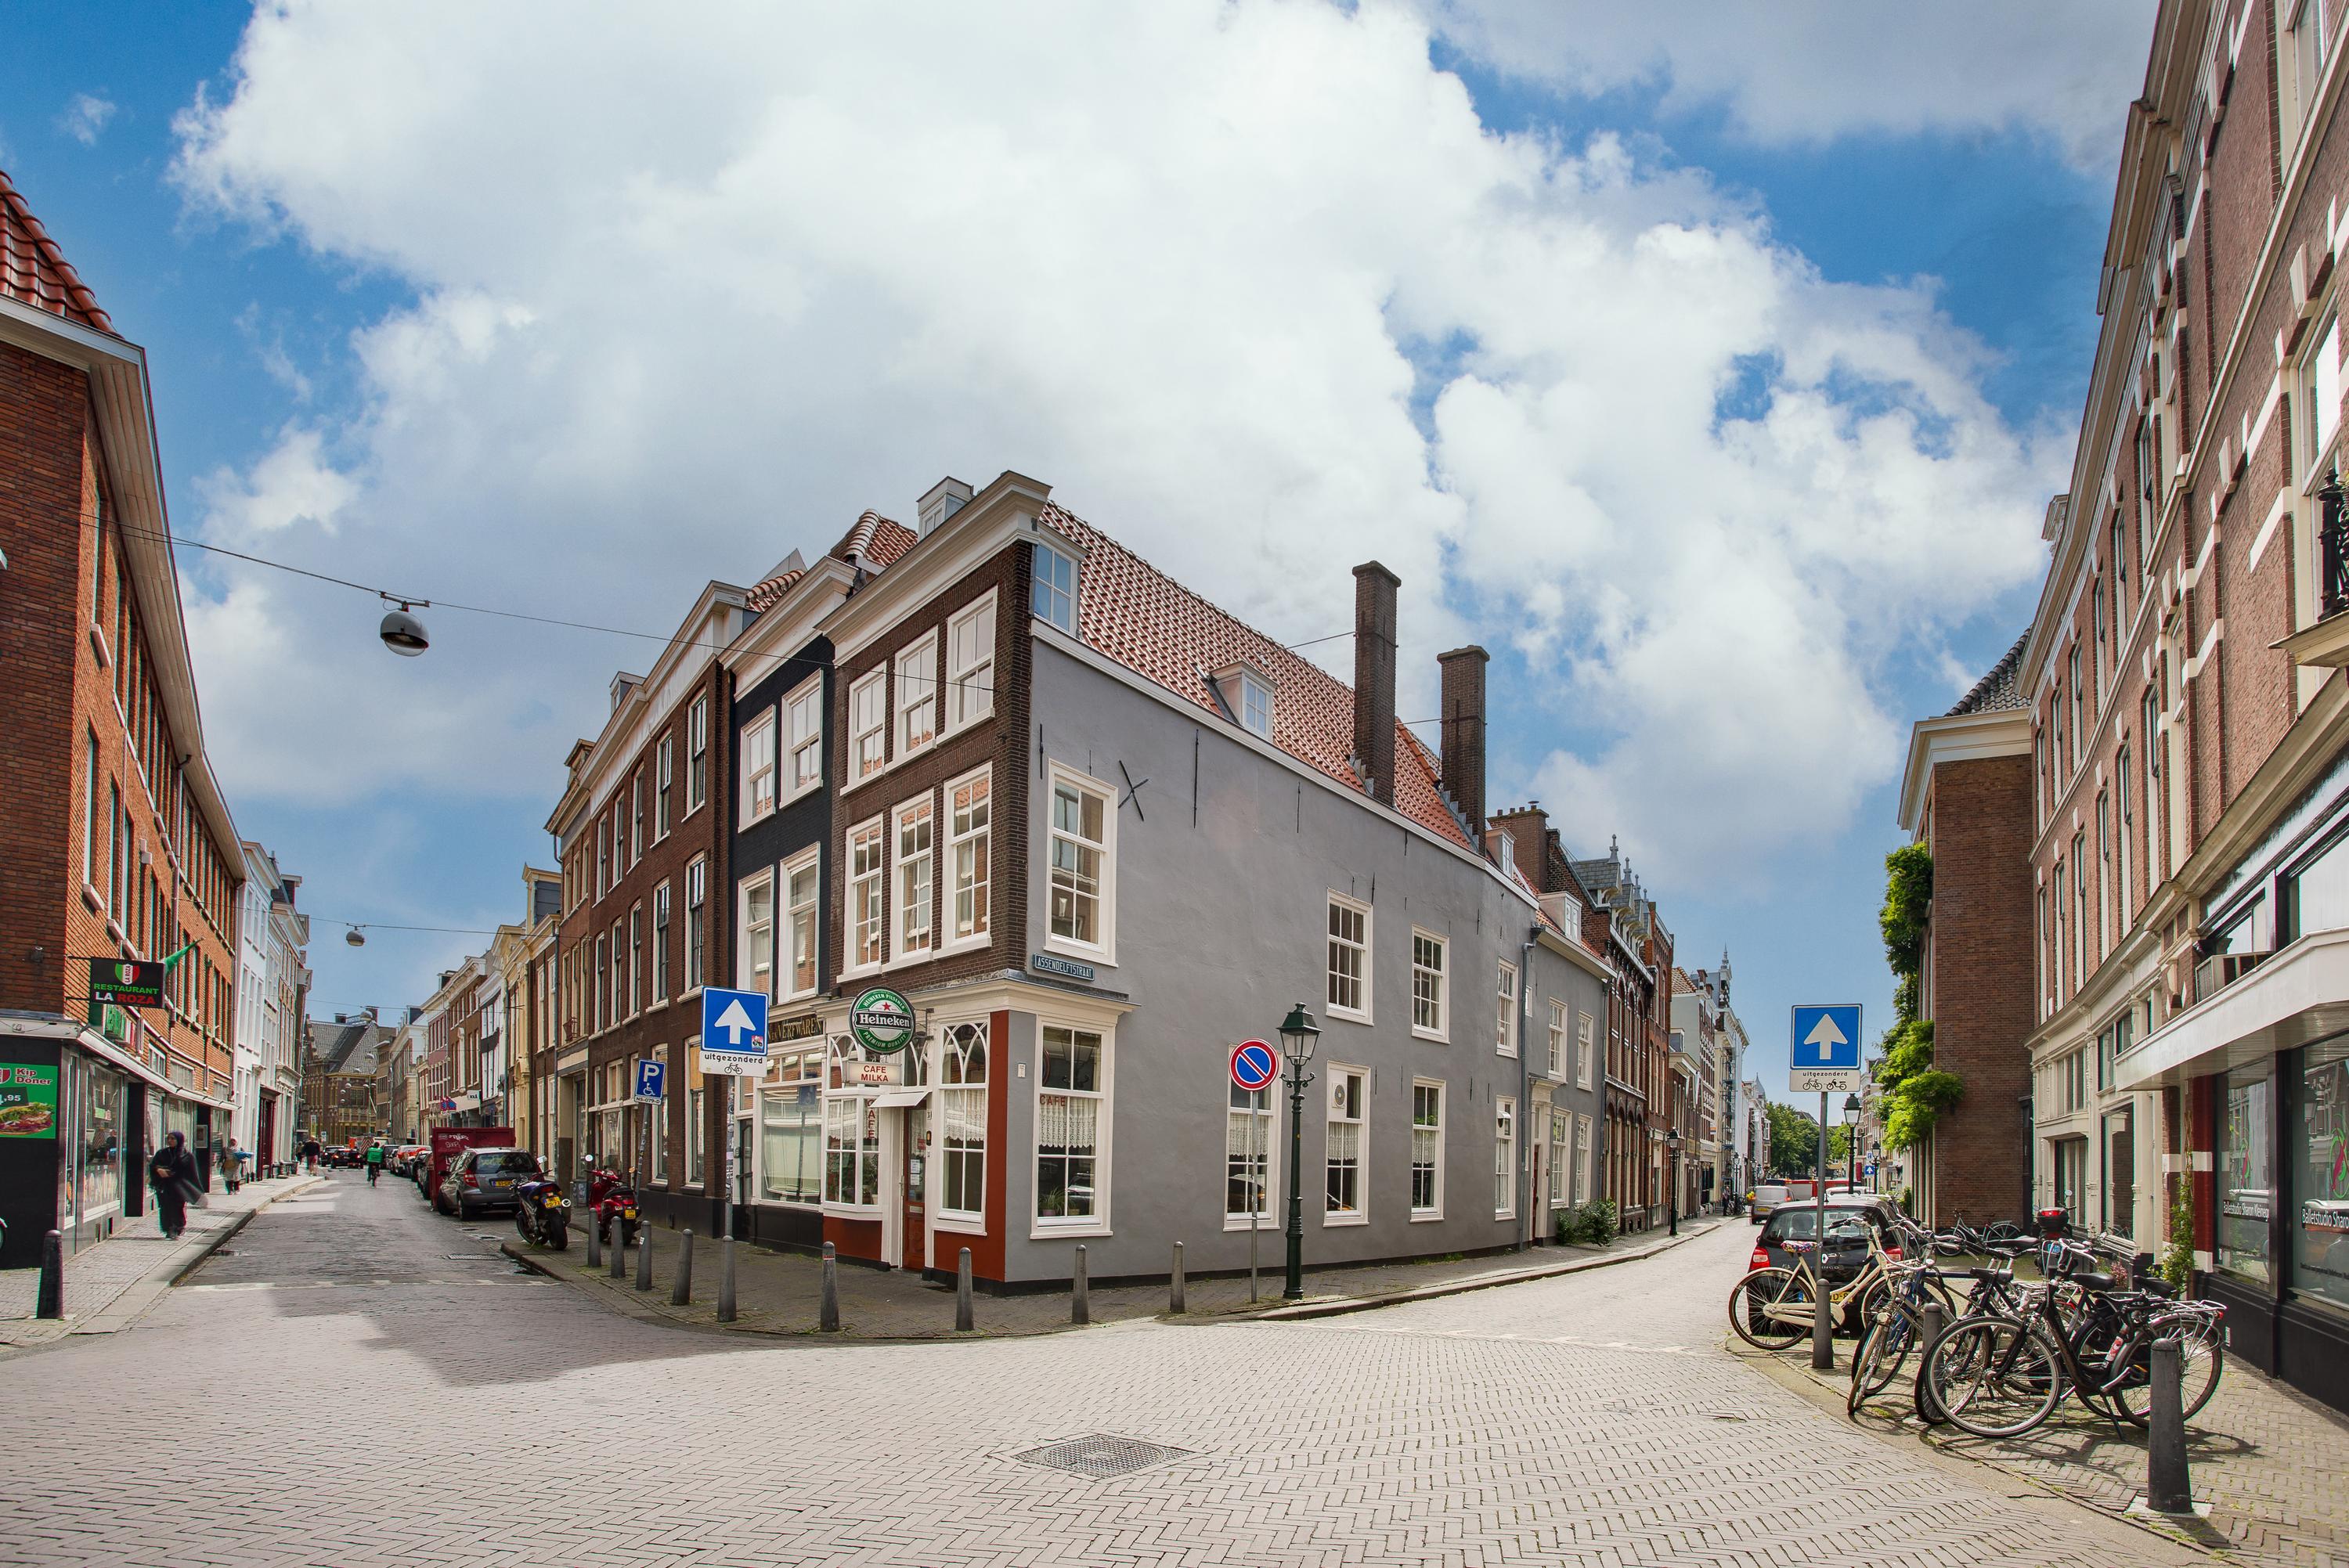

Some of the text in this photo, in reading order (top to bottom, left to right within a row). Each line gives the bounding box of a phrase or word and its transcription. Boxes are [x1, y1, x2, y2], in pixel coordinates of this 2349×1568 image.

[1037, 957, 1092, 978] ASSENDELFTSTRAAT
[94, 983, 159, 994] RESTAURANT
[96, 991, 156, 1004] LA ROZA
[863, 993, 886, 1007] HEINEKEN
[859, 1014, 910, 1027] Heineken
[864, 1031, 907, 1047] PREMIUM QUALITY
[704, 1053, 763, 1064] uitgezonderd
[16, 1068, 37, 1076] Kip
[643, 1064, 659, 1082] P
[861, 1073, 889, 1082] MILKA
[16, 1076, 52, 1085] Döner
[1040, 1094, 1066, 1107] CAFE
[2302, 1208, 2333, 1227] Balletstudio
